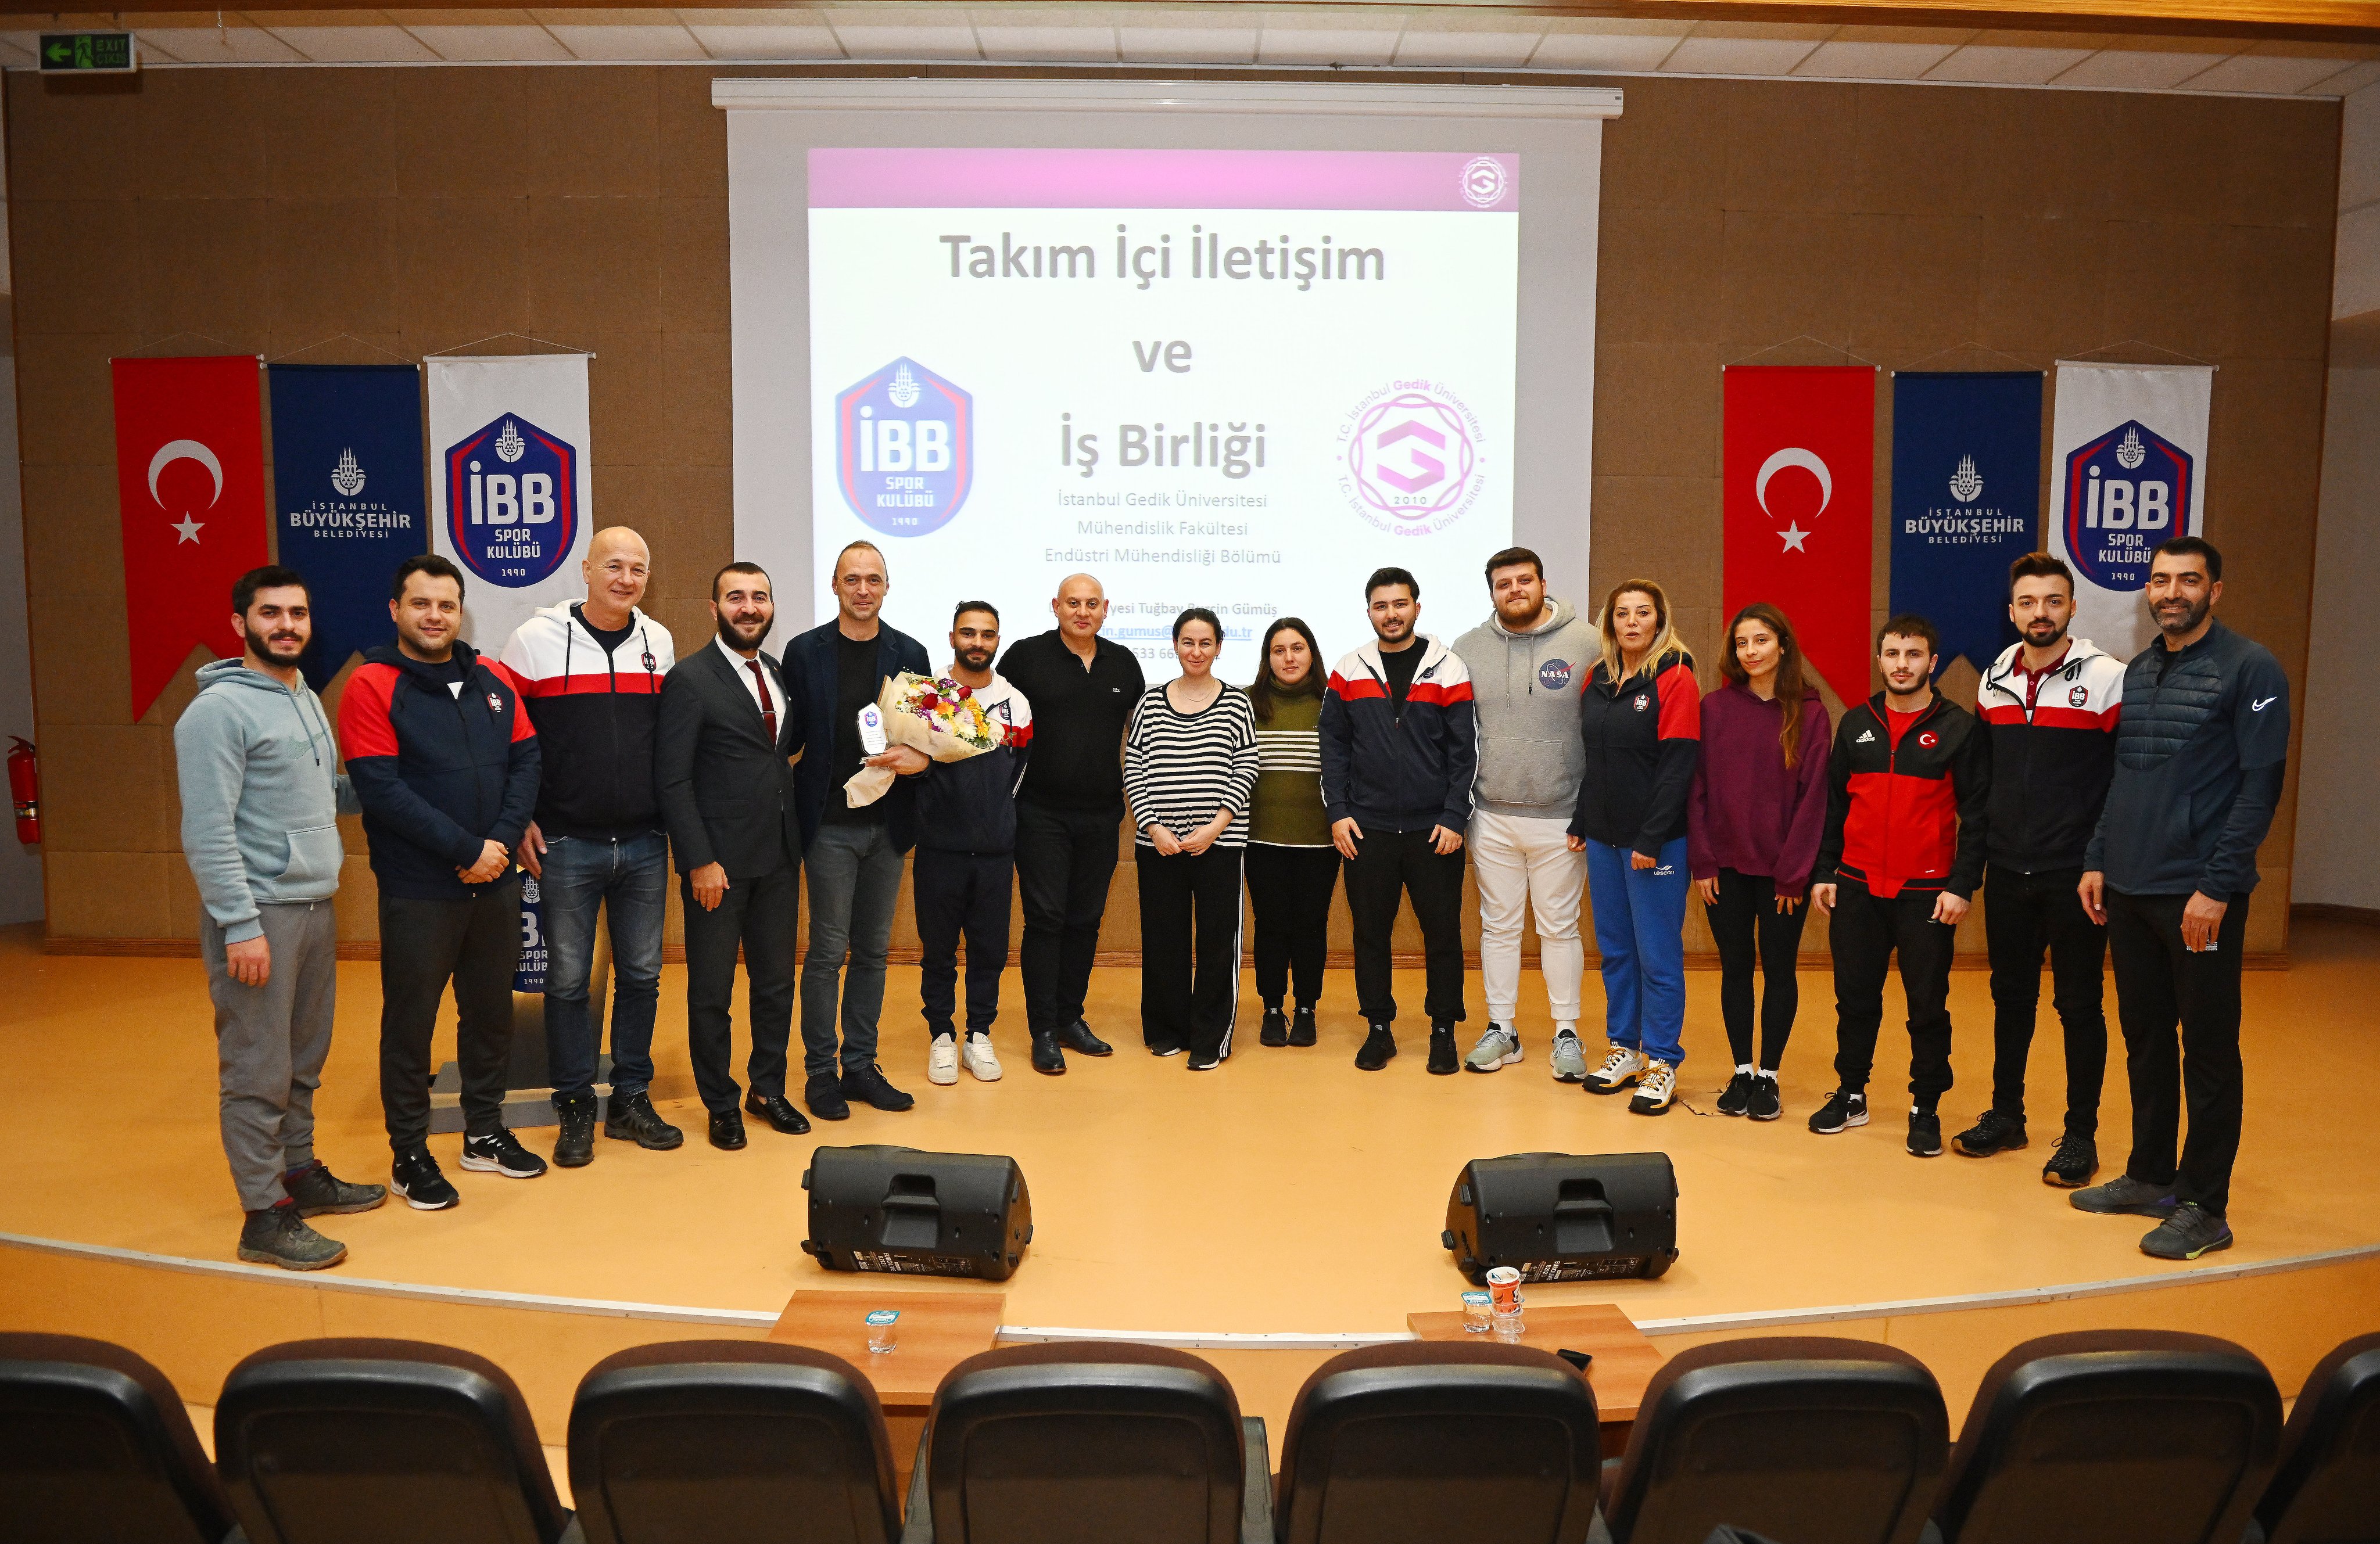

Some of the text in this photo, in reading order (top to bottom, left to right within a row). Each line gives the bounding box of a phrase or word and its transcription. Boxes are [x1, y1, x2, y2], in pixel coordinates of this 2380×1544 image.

[96, 39, 126, 51] EXIT
[940, 224, 1385, 292] Takım İçi İletişim
[1132, 340, 1193, 374] ve
[1345, 383, 1391, 421] İstanbul
[1393, 379, 1432, 391] Gedik
[1434, 382, 1486, 443] Üniversitesi
[859, 405, 951, 472] İBB
[1062, 412, 1267, 480] İş Birliği
[885, 476, 924, 490] SPOR
[469, 460, 555, 525] İBB
[876, 490, 934, 508] KULÜBÜ
[1058, 489, 1268, 508] İstanbul Gedik Üniversitesi
[1394, 496, 1427, 505] 2010
[2086, 465, 2170, 530] İBB
[312, 501, 387, 510] İSTANBUL
[1349, 495, 1392, 533] İstanbul
[1394, 524, 1433, 537] Gedik
[1433, 474, 1485, 531] Üniversitesi
[1929, 507, 2003, 516] İSTANBUL
[290, 509, 411, 530] BÜYÜKŞEHİR
[892, 517, 917, 526] 1990
[1905, 515, 2025, 536] BÜYÜKŞEHİR
[314, 529, 389, 538] BELEDİYESİ
[494, 529, 531, 541] SPOR
[1078, 520, 1249, 536] Mühendislik Fakültesi
[1928, 534, 2002, 544] BELEDİYESİ
[2108, 533, 2144, 547] SPOR
[487, 541, 541, 559] KULÜBÜ
[1045, 548, 1282, 567] Endüstri Mühendisliği Bölümü
[2098, 547, 2151, 563] KULÜBÜ
[501, 568, 526, 576] 1990
[2111, 572, 2135, 580] 1990
[1110, 603, 1135, 617] yesi
[1138, 602, 1183, 617] Tuğbay
[1232, 602, 1278, 618] Gümüş
[1541, 670, 1569, 678] NASA
